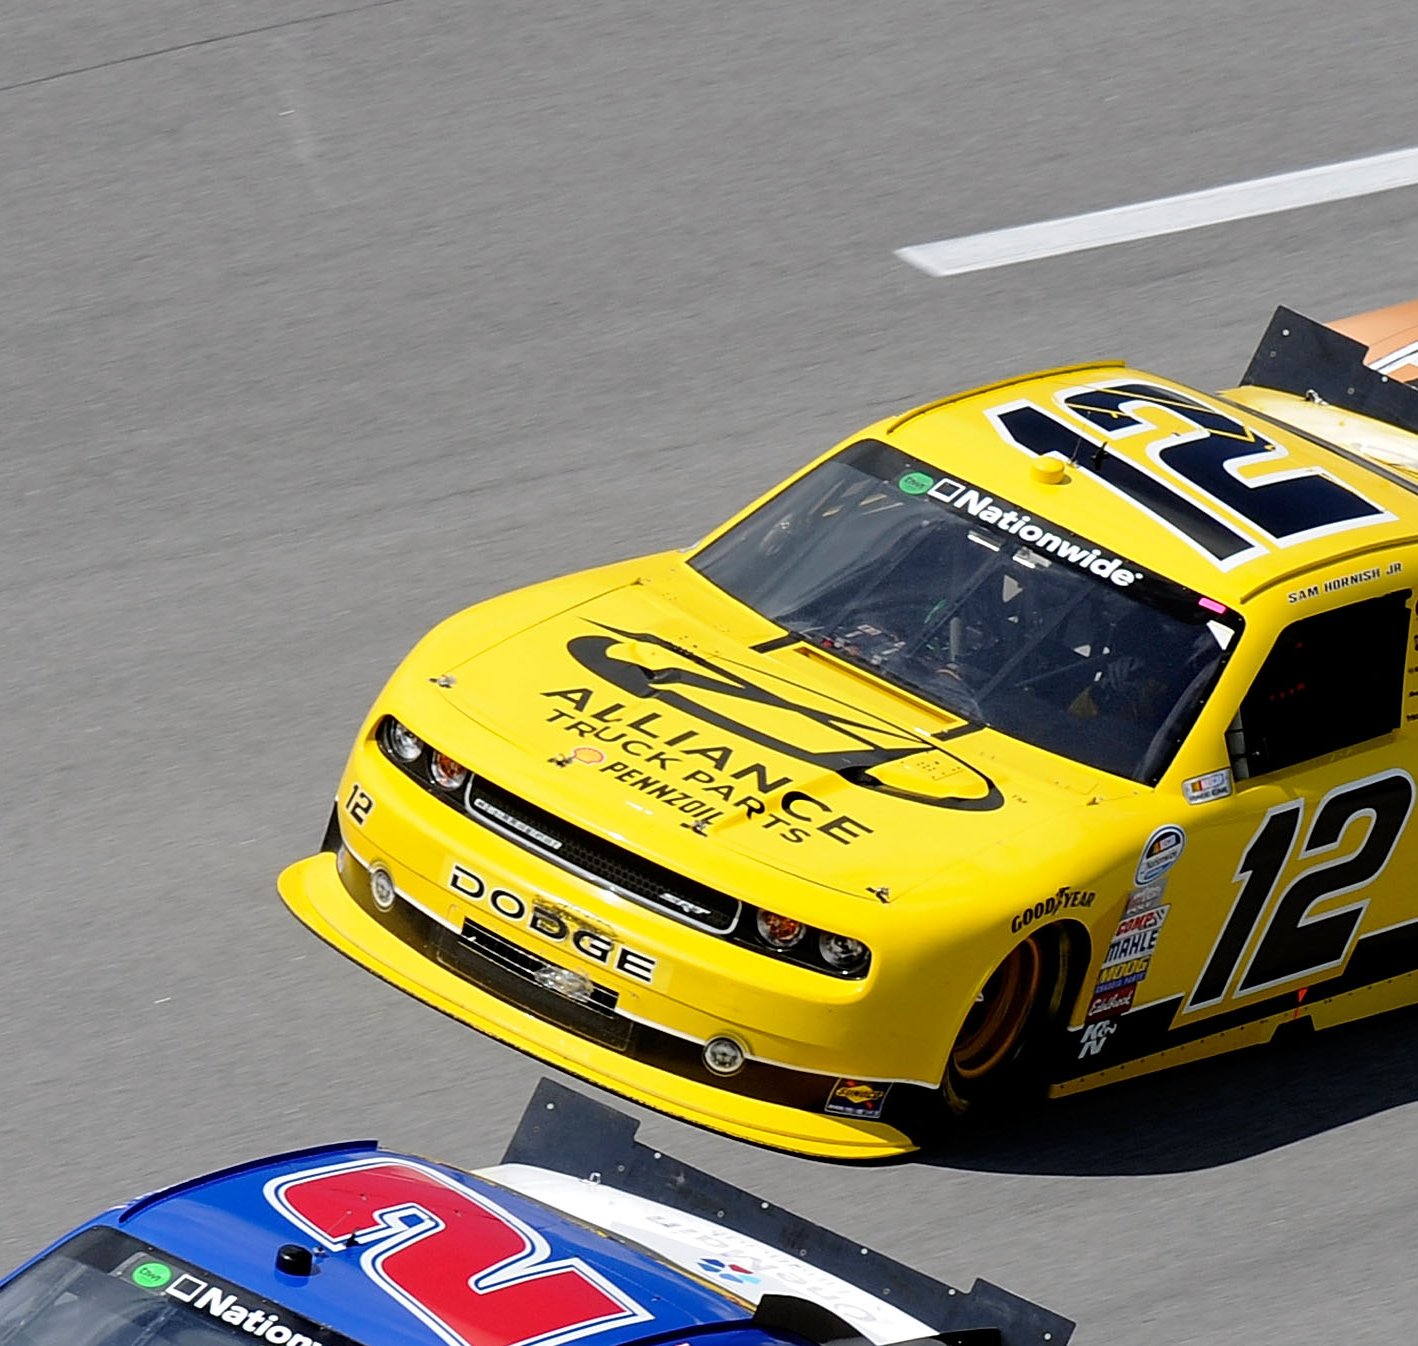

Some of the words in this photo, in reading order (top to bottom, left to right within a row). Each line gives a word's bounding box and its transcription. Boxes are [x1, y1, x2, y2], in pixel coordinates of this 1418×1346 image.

[983, 378, 1400, 573] 12
[957, 488, 1135, 588] Nationwide
[1287, 586, 1319, 604] SAM
[1323, 568, 1380, 593] HORNISH
[1385, 562, 1403, 576] JR
[541, 688, 874, 845] ALLIANCE
[546, 709, 683, 771] TRUCK
[682, 769, 812, 844] PARTS
[599, 761, 726, 827] PENNZOIL
[344, 783, 374, 826] 12
[1011, 885, 1096, 933] GOODYEAR
[1183, 768, 1416, 1013] 12
[449, 863, 658, 985] DODGE
[1105, 930, 1159, 962] MAHLE
[1087, 990, 1134, 1017] Edelbrock
[1099, 956, 1151, 985] MOOG
